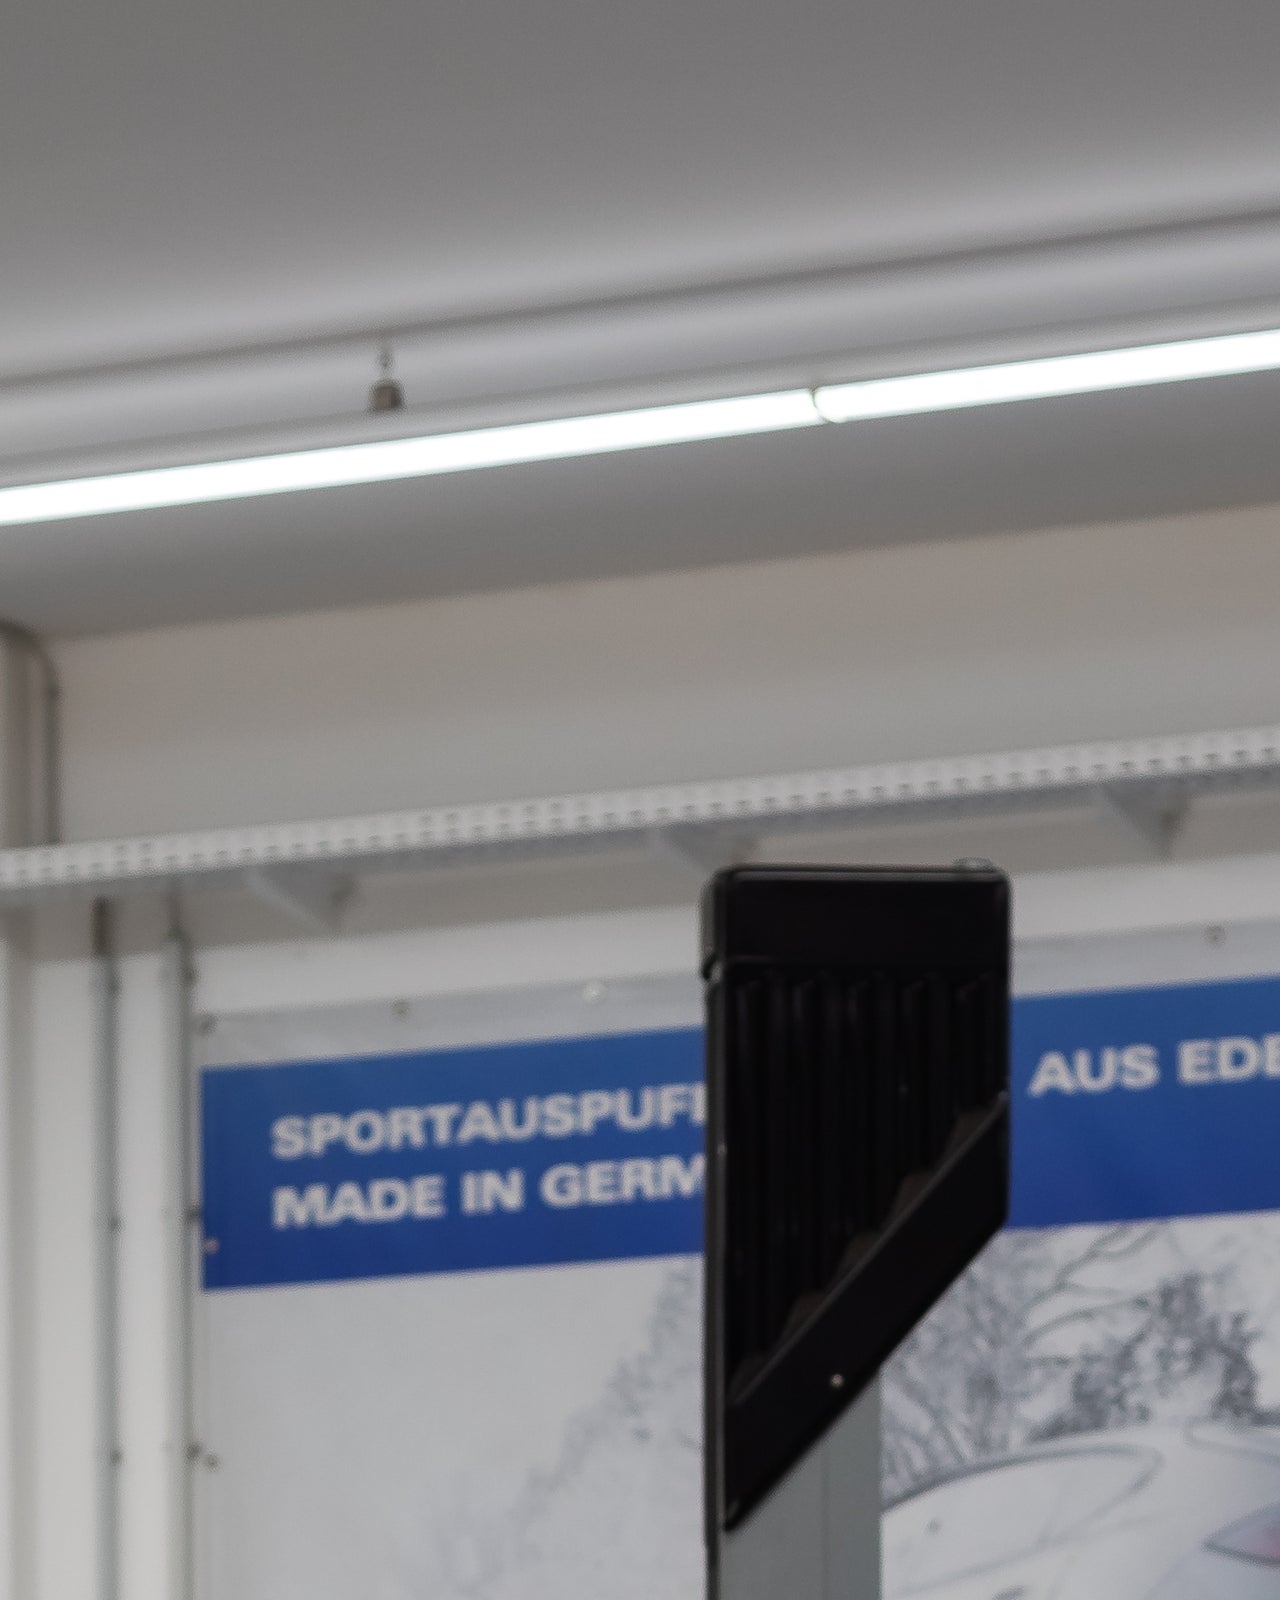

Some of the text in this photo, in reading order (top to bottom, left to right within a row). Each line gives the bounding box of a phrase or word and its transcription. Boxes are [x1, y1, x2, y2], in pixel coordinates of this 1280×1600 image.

[1027, 1043, 1160, 1097] AUS
[272, 1154, 706, 1230] MADE IN GERM
